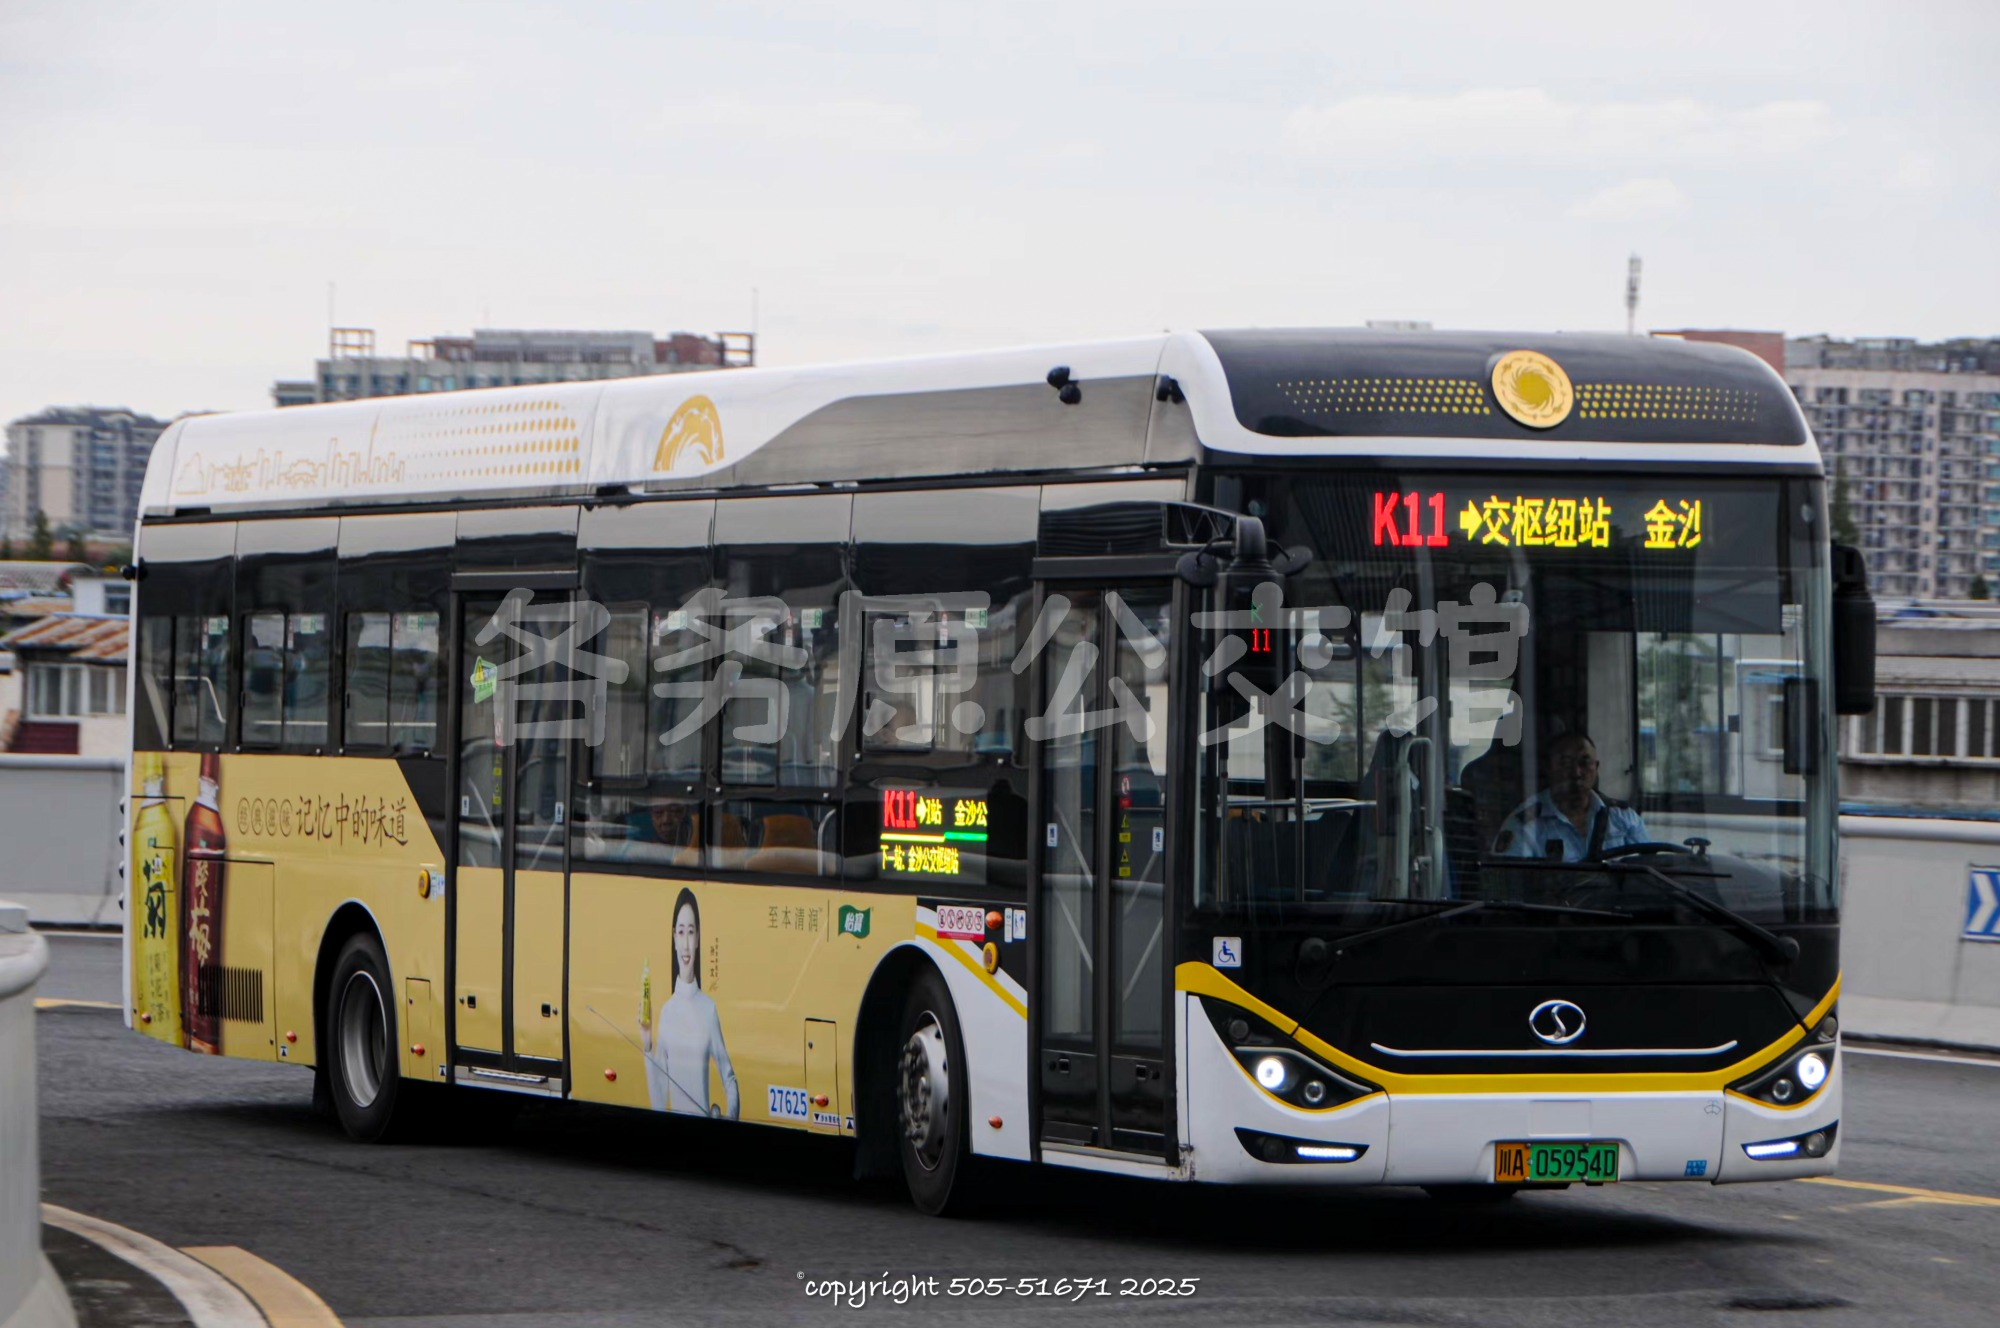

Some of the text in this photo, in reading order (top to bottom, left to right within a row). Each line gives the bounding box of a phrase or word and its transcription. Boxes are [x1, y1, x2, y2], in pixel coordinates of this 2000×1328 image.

[1374, 492, 1448, 546] K11
[1482, 495, 1611, 547] 交枢纽站
[1252, 628, 1271, 652] 11
[296, 792, 408, 848] 记忆中的味道
[884, 790, 917, 829] K11
[954, 799, 988, 827] 金沙公
[769, 1088, 808, 1116] 27625
[1499, 1149, 1617, 1177] 川A 05954D
